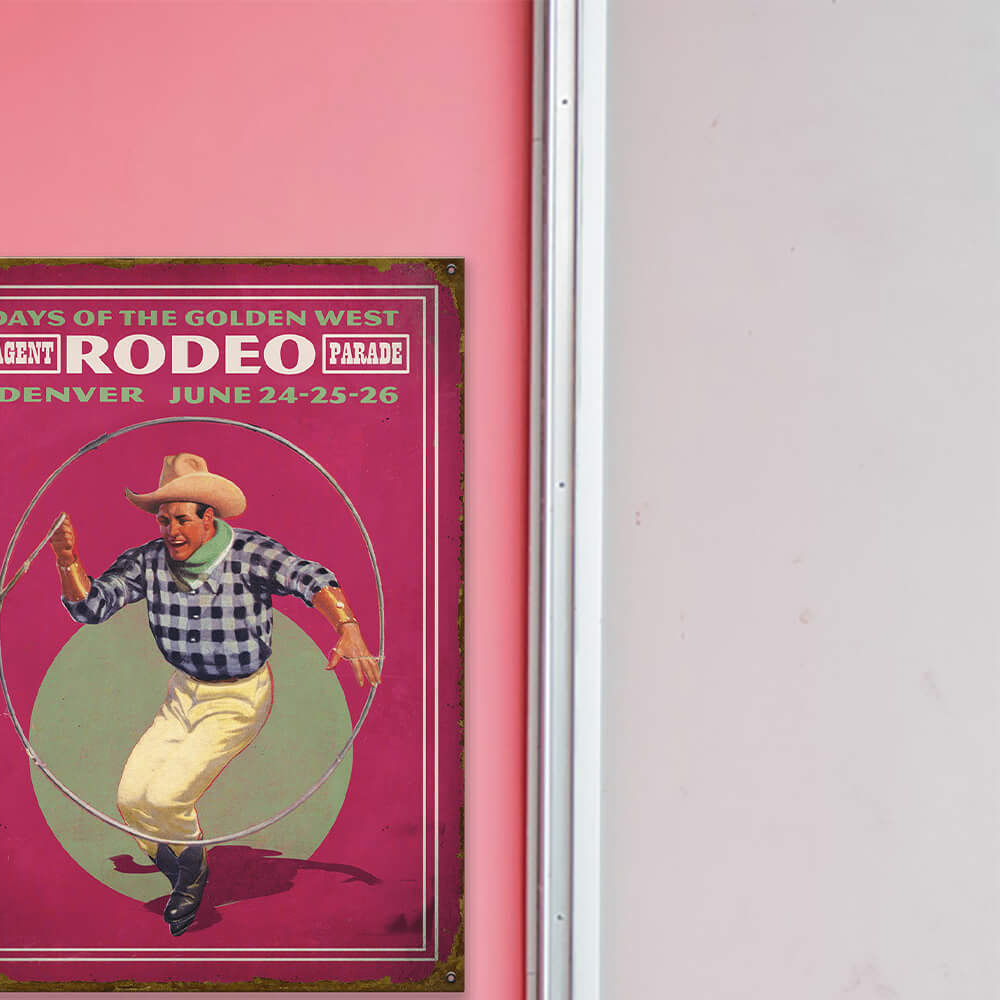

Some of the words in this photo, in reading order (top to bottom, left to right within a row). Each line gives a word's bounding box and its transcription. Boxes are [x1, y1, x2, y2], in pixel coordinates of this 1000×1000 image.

[72, 309, 112, 327] OF
[118, 309, 177, 327] THE
[184, 309, 307, 327] GOLDEN
[313, 309, 400, 327] WEST
[65, 333, 317, 376] RODEO
[328, 341, 403, 366] PARADE
[168, 385, 252, 405] JUNE
[258, 385, 399, 405] 24-25-26
